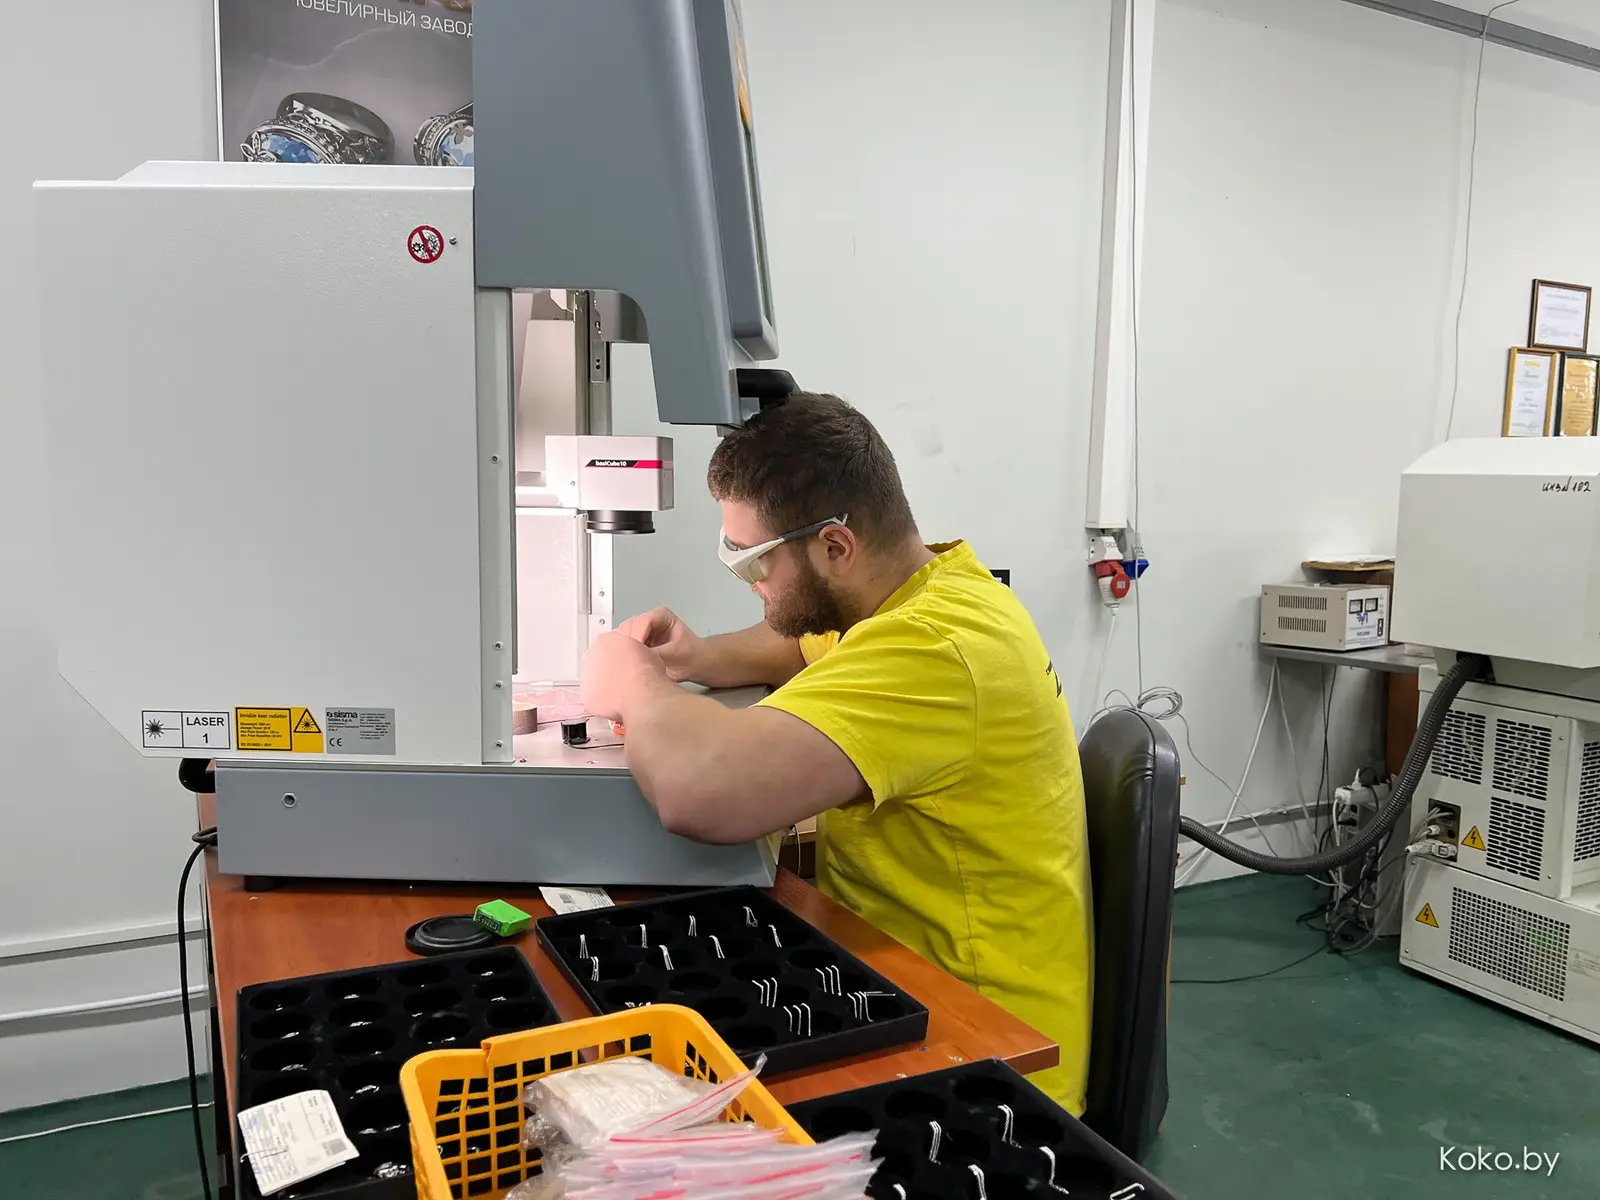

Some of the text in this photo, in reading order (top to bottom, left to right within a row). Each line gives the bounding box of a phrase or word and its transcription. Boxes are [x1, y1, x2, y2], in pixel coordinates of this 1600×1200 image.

[333, 710, 358, 718] sisma
[186, 716, 225, 727] LASER
[202, 732, 209, 744] 1
